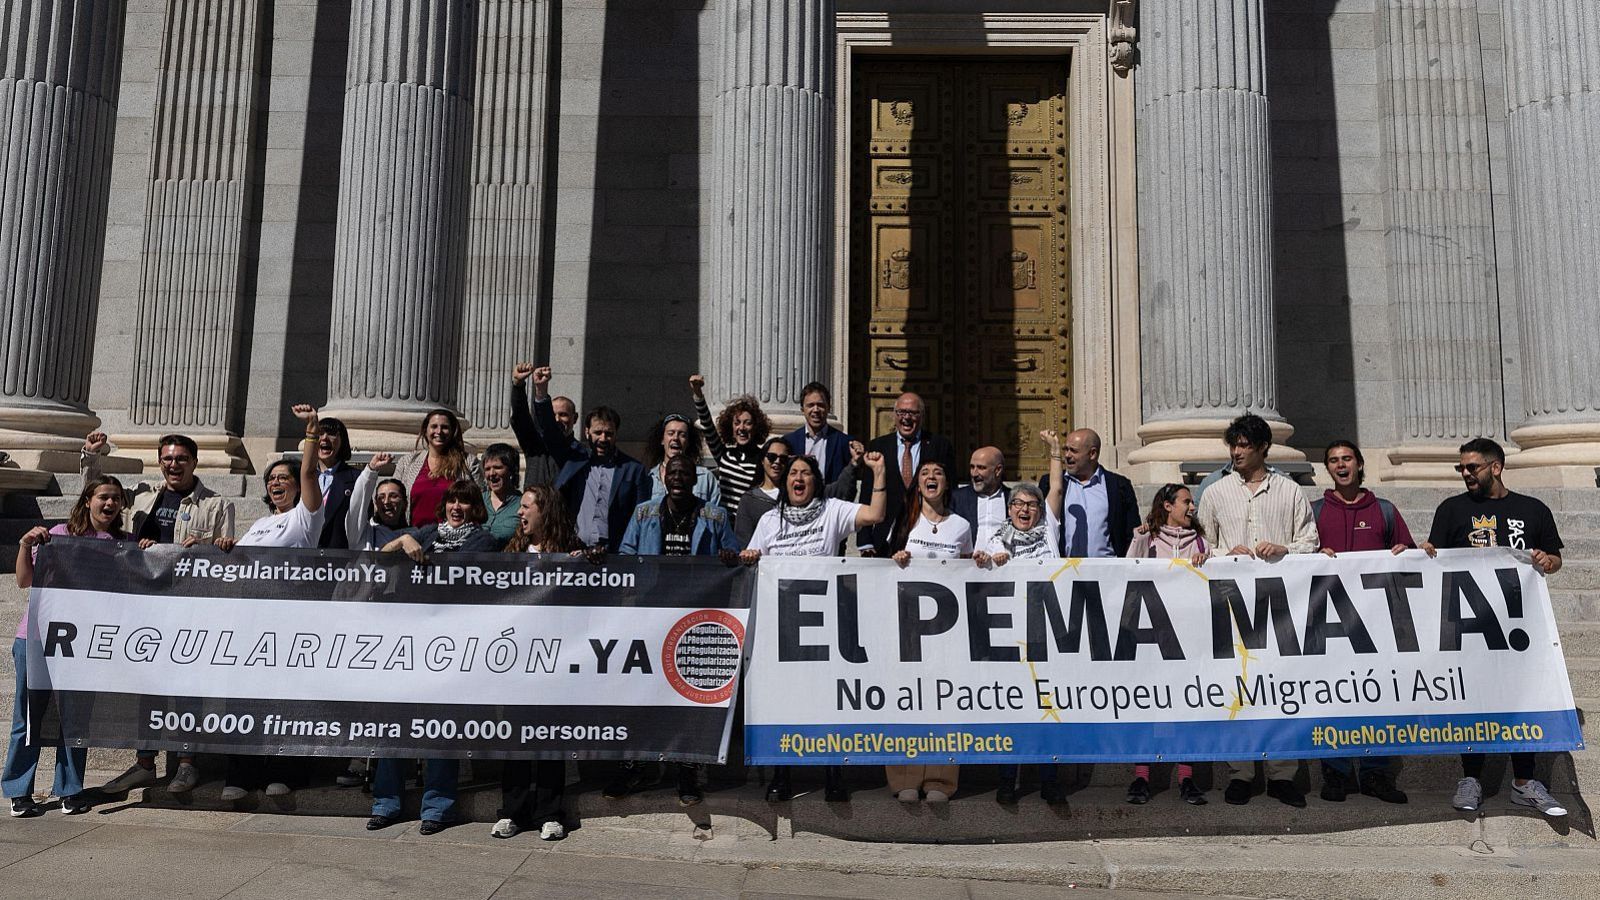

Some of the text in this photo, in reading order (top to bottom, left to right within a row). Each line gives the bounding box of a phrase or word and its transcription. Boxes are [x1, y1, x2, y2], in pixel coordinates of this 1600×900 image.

[174, 558, 386, 583] #RegularizacionYa
[778, 568, 1530, 663] El PEMA MATA!
[837, 666, 1466, 720] No al Pacte Europeu de Migració i Asil
[149, 711, 628, 743] 500.000 firmas para 500.000 personas
[1311, 721, 1543, 749] #QueNoTeVendanElPacto
[779, 732, 1013, 758] #QueNoEtVenguinElPacte
